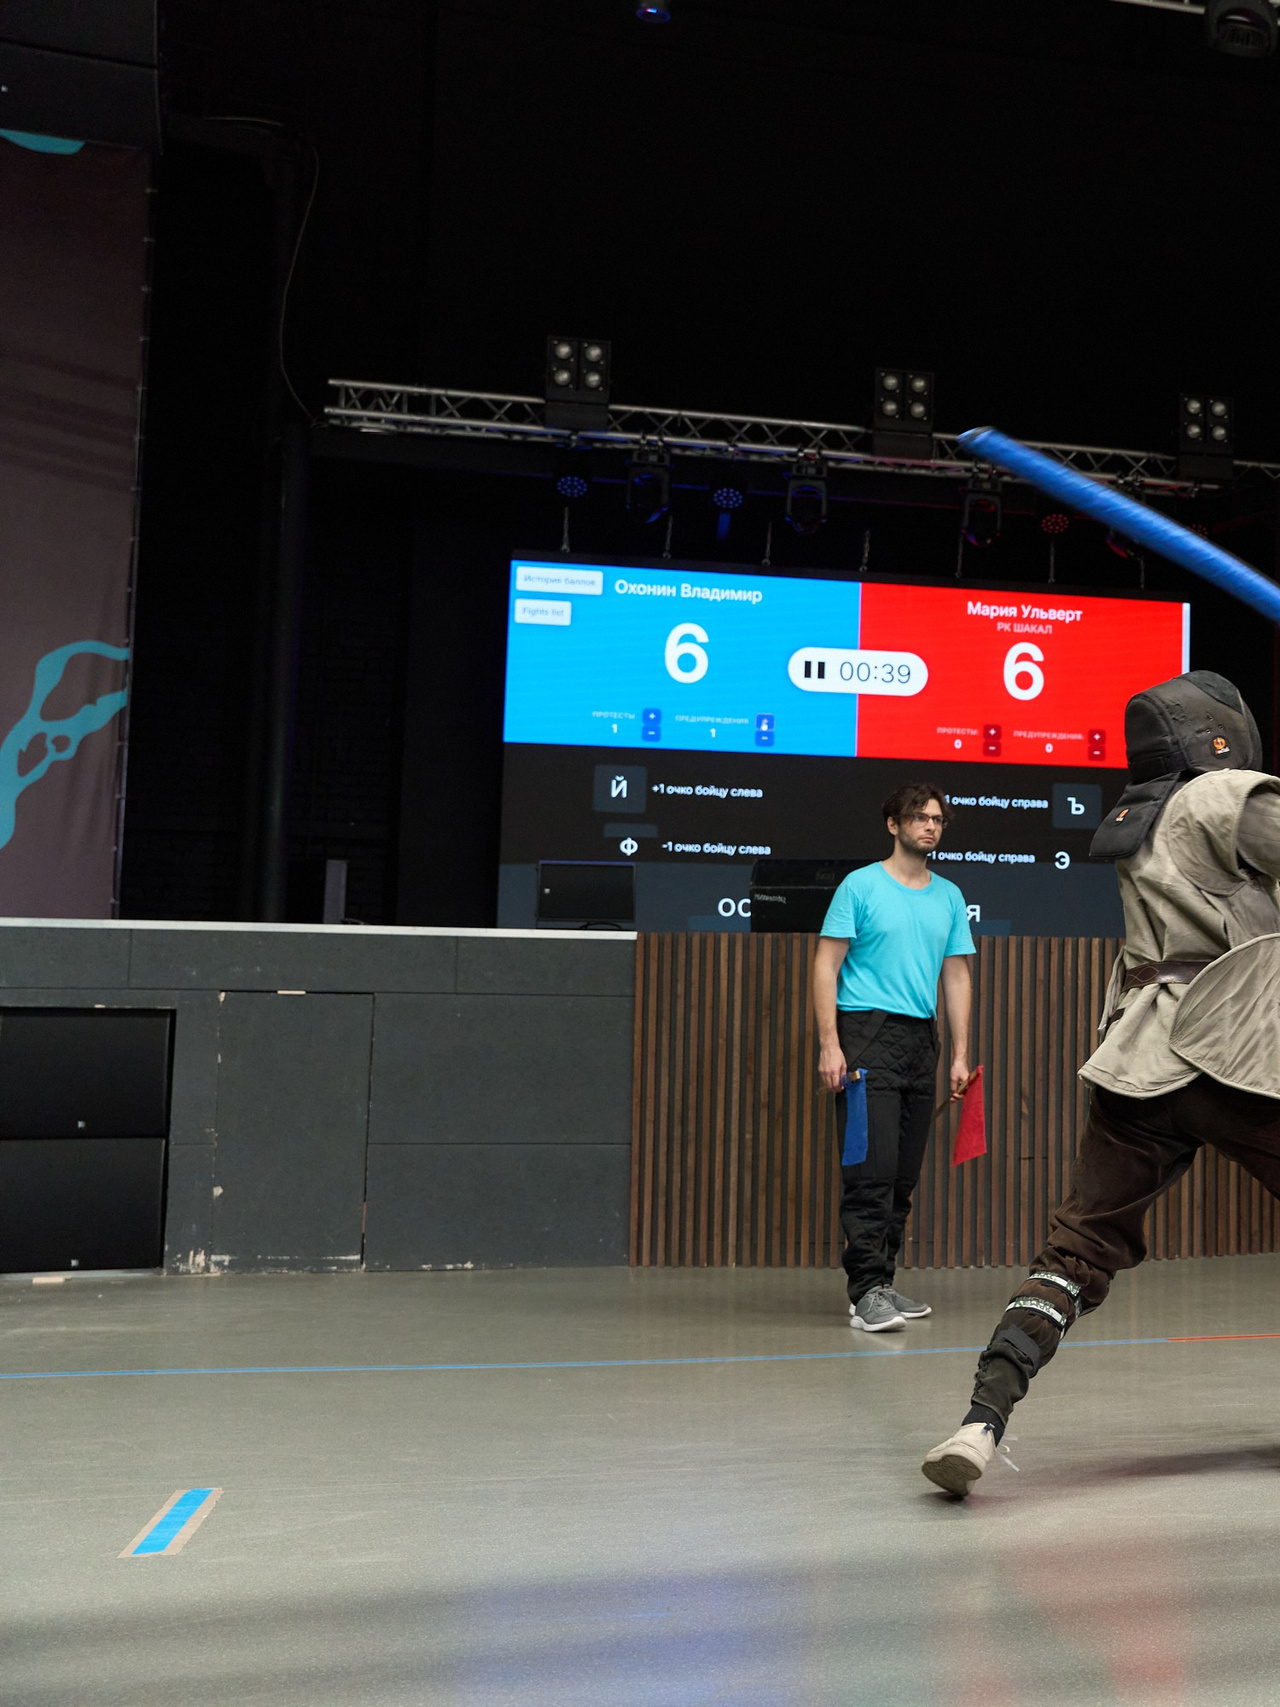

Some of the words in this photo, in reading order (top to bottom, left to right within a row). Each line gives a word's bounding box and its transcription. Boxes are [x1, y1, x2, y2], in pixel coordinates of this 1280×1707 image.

[614, 578, 676, 598] Охонин
[680, 582, 763, 605] Владимир
[522, 606, 549, 617] Fights
[551, 607, 565, 617] list
[967, 600, 1018, 620] Мария
[1021, 604, 1083, 624] Ульверт
[997, 621, 1011, 632] РК
[1013, 622, 1053, 635] ШАКАЛ
[664, 622, 709, 684] 6
[839, 660, 912, 685] 00:39
[1003, 641, 1045, 701] 6
[611, 723, 618, 734] 1
[710, 728, 716, 738] 1
[954, 738, 962, 750] 0
[1045, 742, 1053, 754] 0
[611, 775, 628, 799] Й
[651, 782, 665, 794] +1
[666, 784, 694, 796] очко
[694, 784, 729, 799] бойцу
[730, 786, 763, 798] слева
[951, 795, 977, 806] очко
[978, 794, 1010, 809] бойцу
[1011, 797, 1049, 810] справа
[1067, 796, 1086, 816] Ъ
[619, 836, 639, 857] Ф
[661, 841, 673, 852] -1
[674, 842, 702, 853] очко
[702, 842, 737, 856] бойцу
[738, 844, 772, 856] слева
[938, 851, 963, 862] очко
[964, 850, 997, 865] бойцу
[998, 853, 1036, 865] справа
[1054, 851, 1071, 870] Э
[718, 897, 751, 918] ОС
